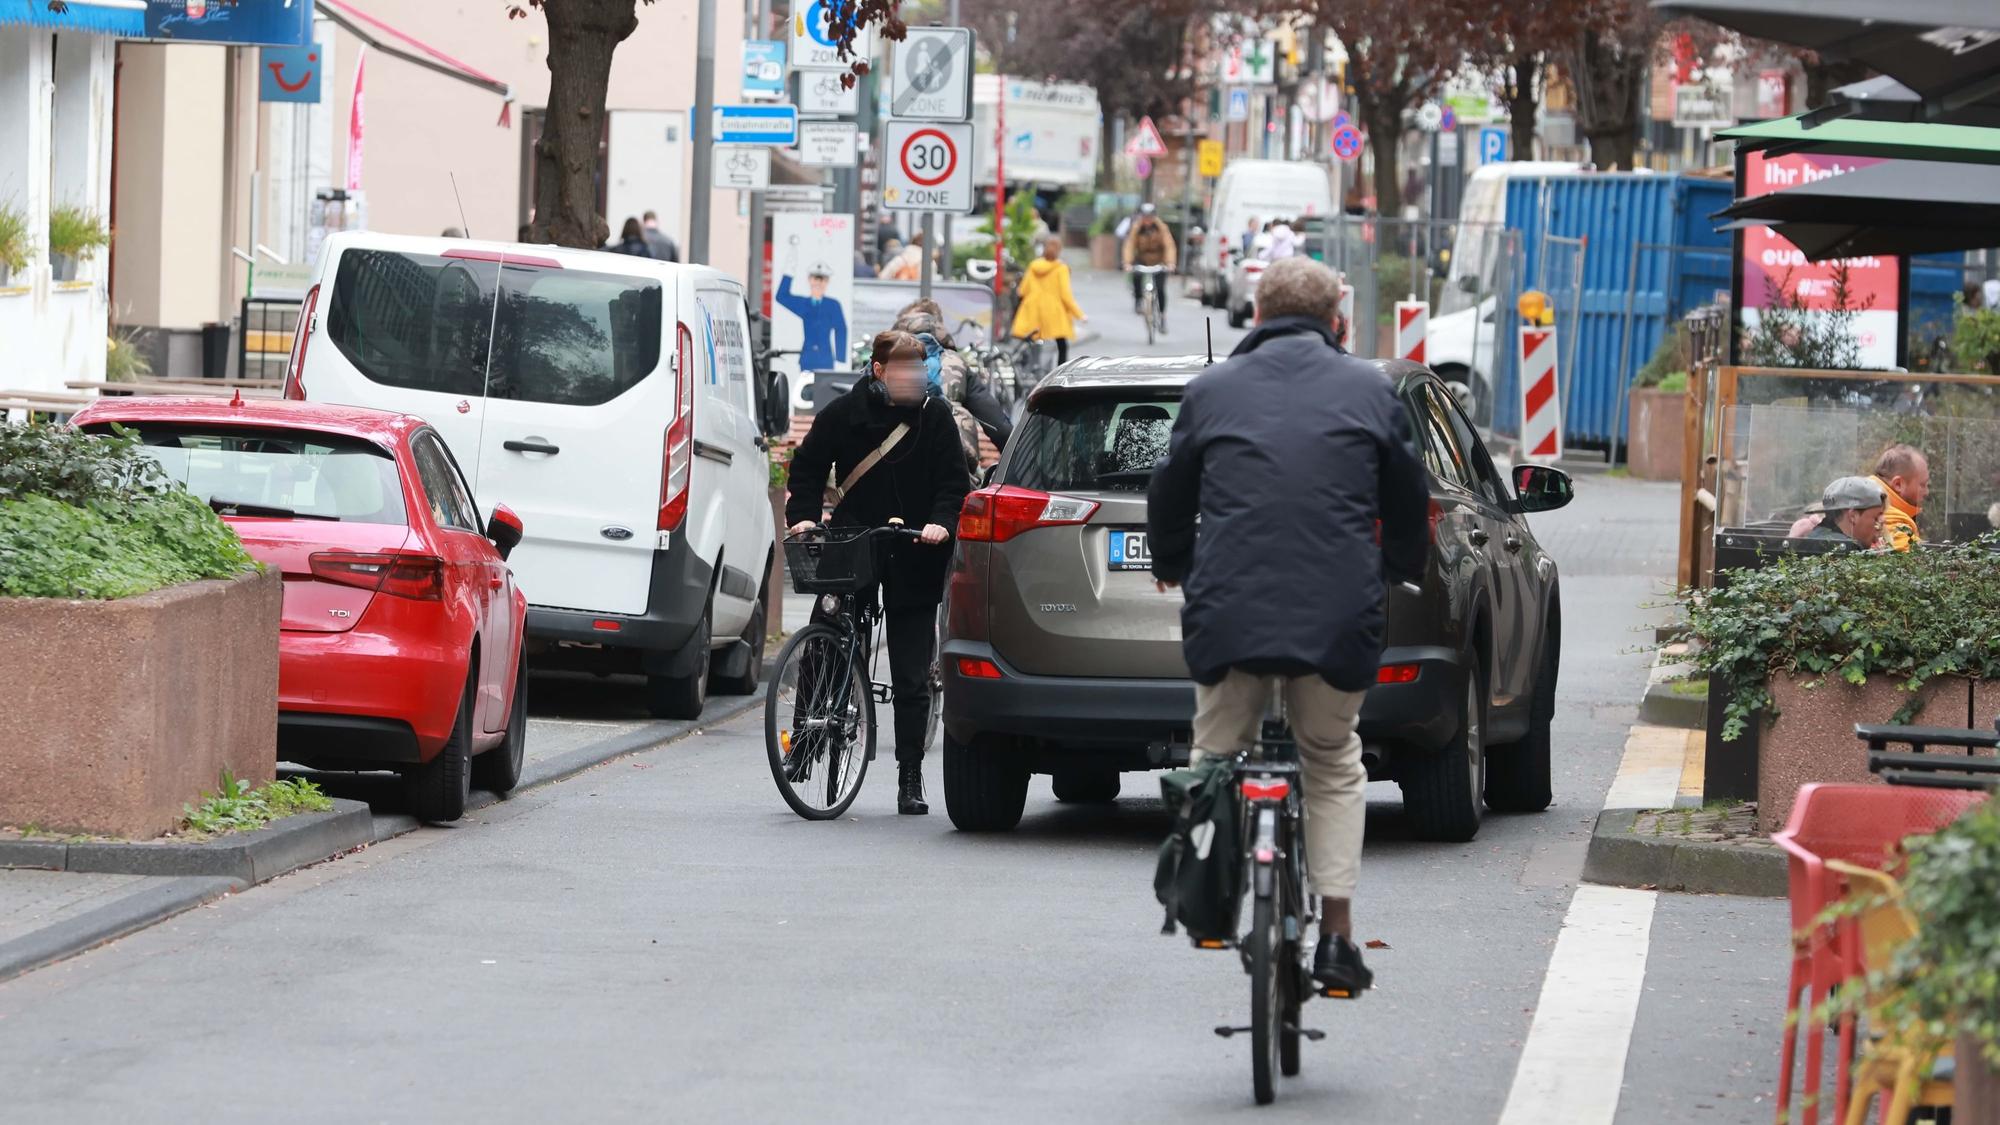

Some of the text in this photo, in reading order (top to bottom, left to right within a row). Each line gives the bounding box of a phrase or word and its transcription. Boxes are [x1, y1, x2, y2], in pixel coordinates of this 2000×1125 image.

[909, 98, 945, 113] ZONE
[720, 119, 790, 130] Einbahnstraße
[912, 144, 946, 171] 30
[1764, 162, 1798, 185] Ihr
[905, 189, 950, 206] ZONE
[328, 609, 350, 617] TDI
[1039, 603, 1077, 612] TOYOTA
